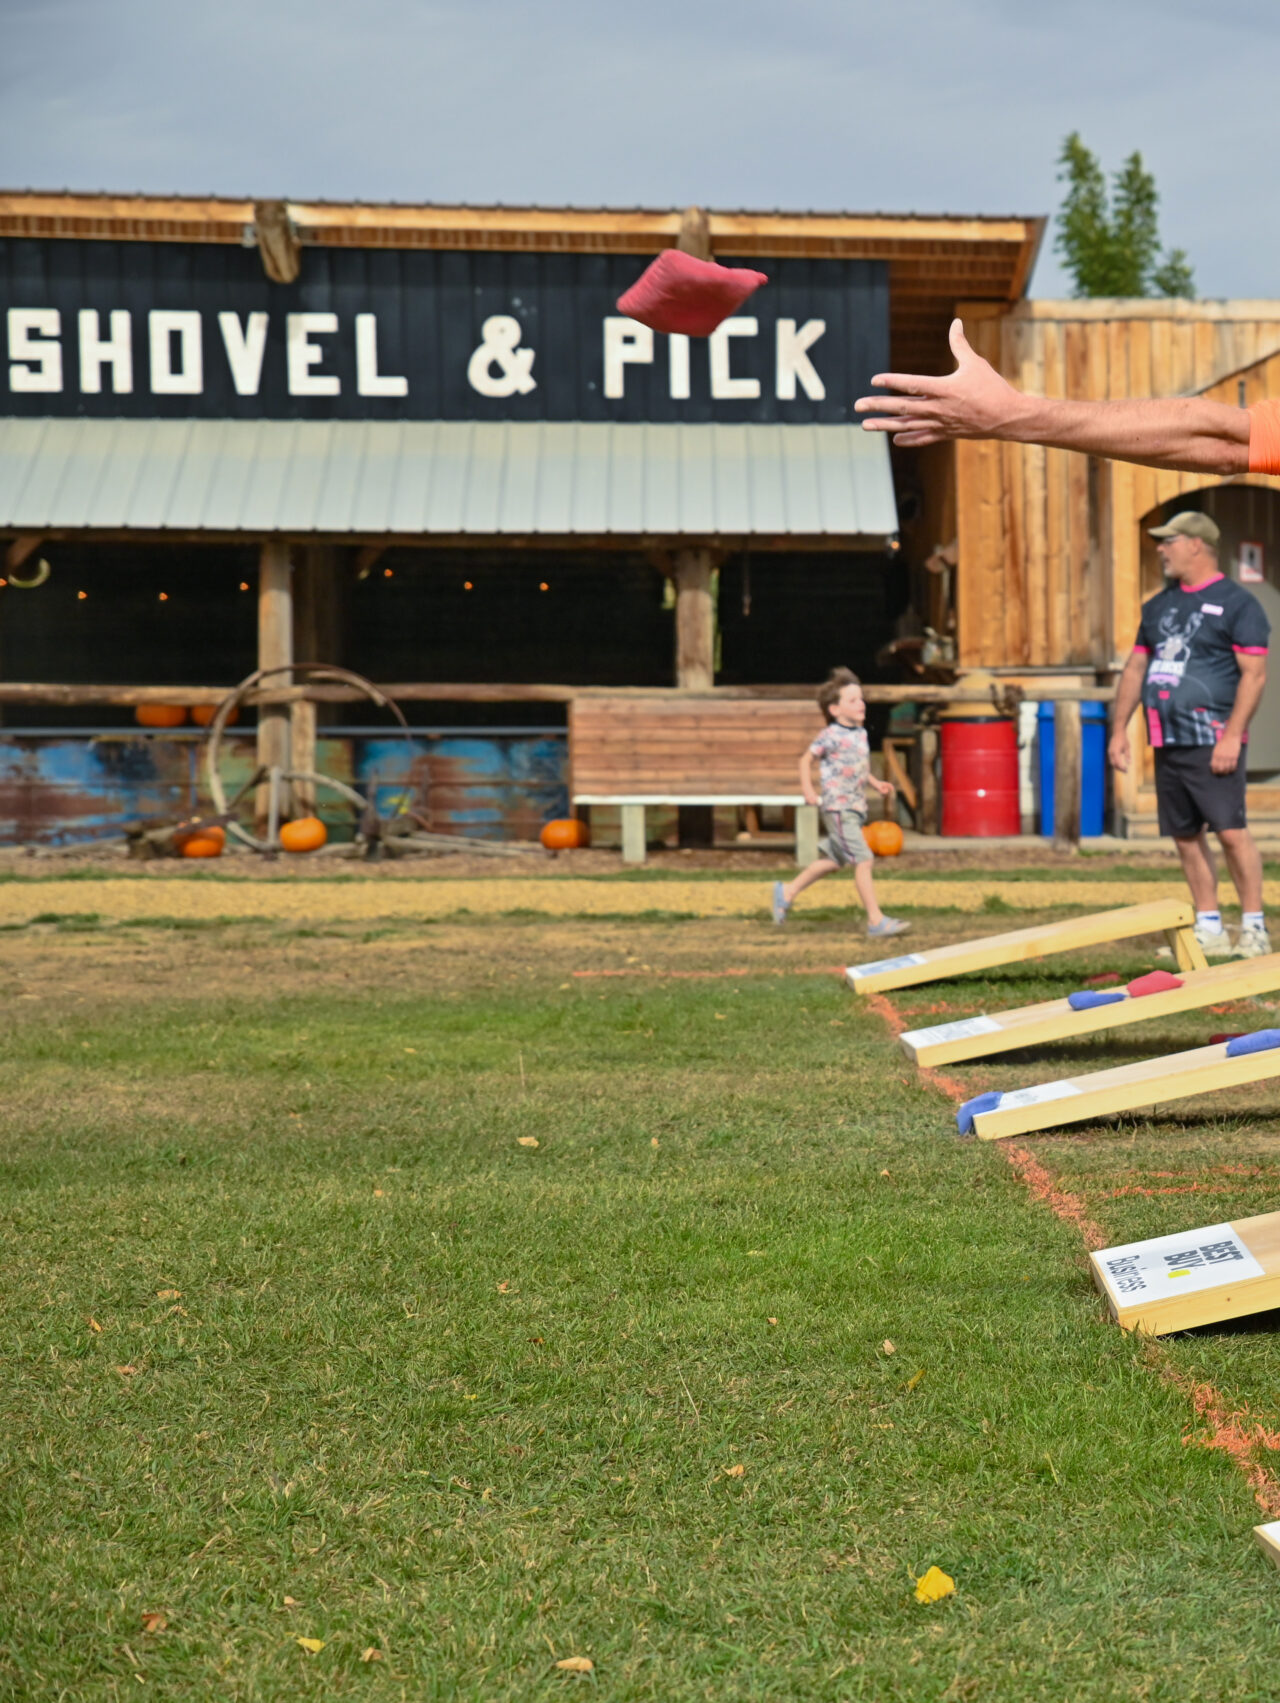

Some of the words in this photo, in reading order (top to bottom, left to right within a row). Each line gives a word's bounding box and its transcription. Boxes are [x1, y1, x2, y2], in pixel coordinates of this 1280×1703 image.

[7, 307, 409, 397] SHOVEL
[467, 314, 538, 397] &
[603, 316, 827, 402] PICK
[1163, 1249, 1206, 1271] BUY
[1198, 1240, 1244, 1266] BEST
[1106, 1254, 1148, 1294] Business
